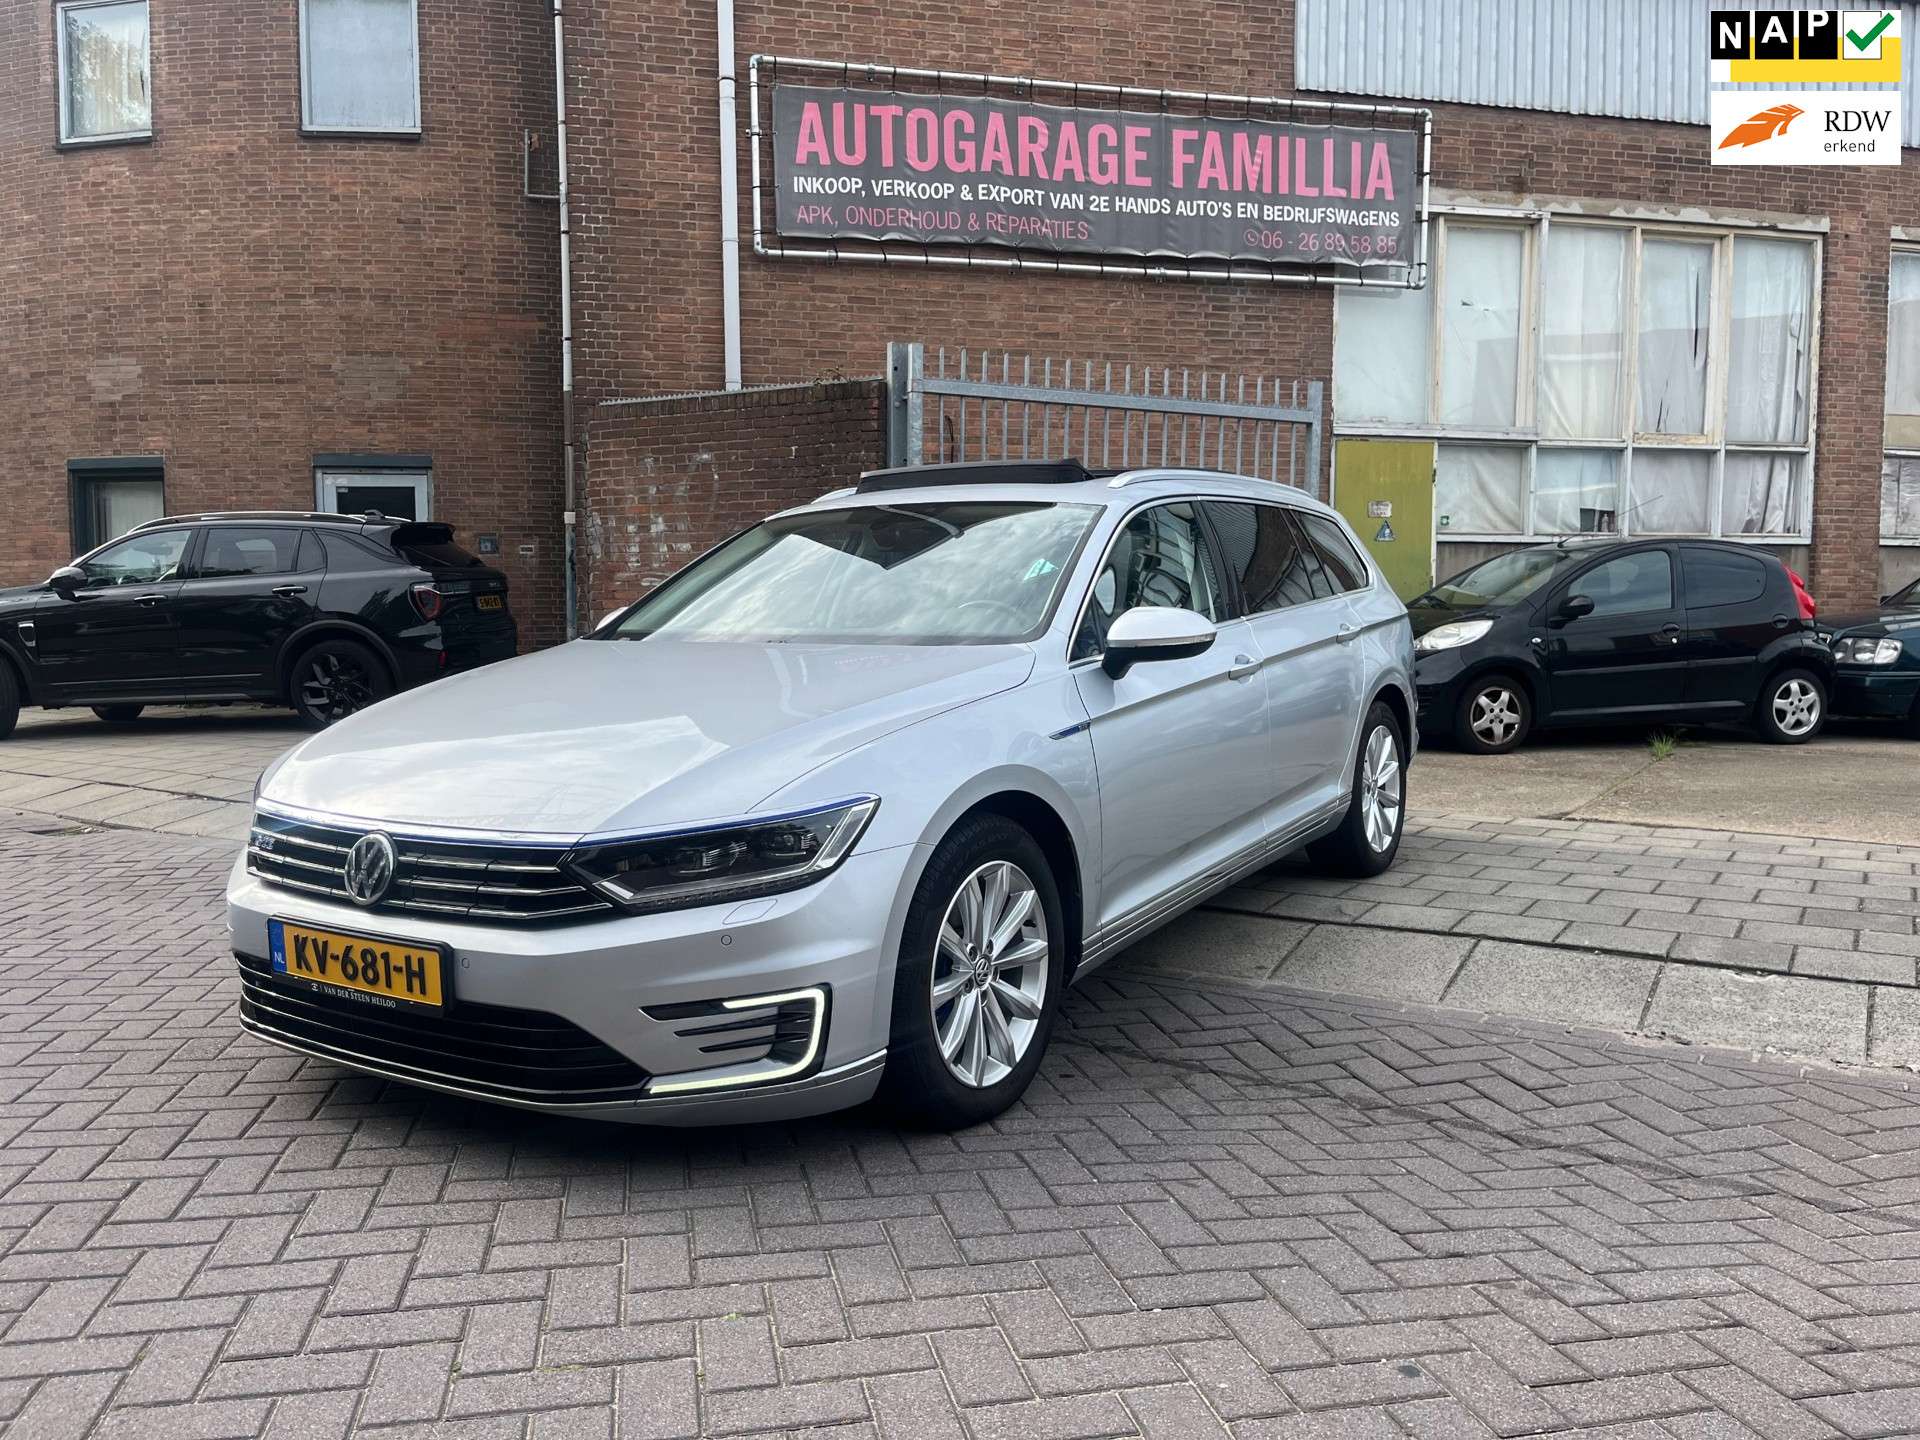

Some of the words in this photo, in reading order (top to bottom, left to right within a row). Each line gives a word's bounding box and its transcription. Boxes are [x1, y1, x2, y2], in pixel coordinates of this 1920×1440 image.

[795, 101, 1152, 187] AUTOGARAGE
[1172, 128, 1395, 200] FAMILLIA
[793, 176, 866, 197] INKOOP,
[871, 180, 955, 200] VERKOOP
[960, 184, 973, 200] &
[978, 184, 1045, 206] EXPORT
[1050, 192, 1083, 210] VAN
[1089, 195, 1109, 212] 2E
[1115, 198, 1171, 215] HANDS
[1175, 200, 1232, 218] AUTO'S
[1237, 202, 1259, 219] EN
[1263, 205, 1400, 227] BEDRIJFSWAGENS
[797, 205, 839, 228] APK,
[846, 206, 961, 230] ONDERHOUD
[967, 212, 980, 231] &
[986, 212, 1089, 240] REPARATIES
[1261, 231, 1283, 249] 06
[1299, 233, 1319, 251] 26
[1324, 233, 1345, 251] 89
[1351, 236, 1371, 254] 58
[1377, 236, 1397, 254] 85
[274, 951, 286, 964] NL
[293, 934, 426, 996] KV-681-H
[324, 985, 336, 995] VAN
[337, 988, 350, 999] DER
[350, 992, 370, 1003] STEEN
[371, 996, 396, 1009] HEILOO
